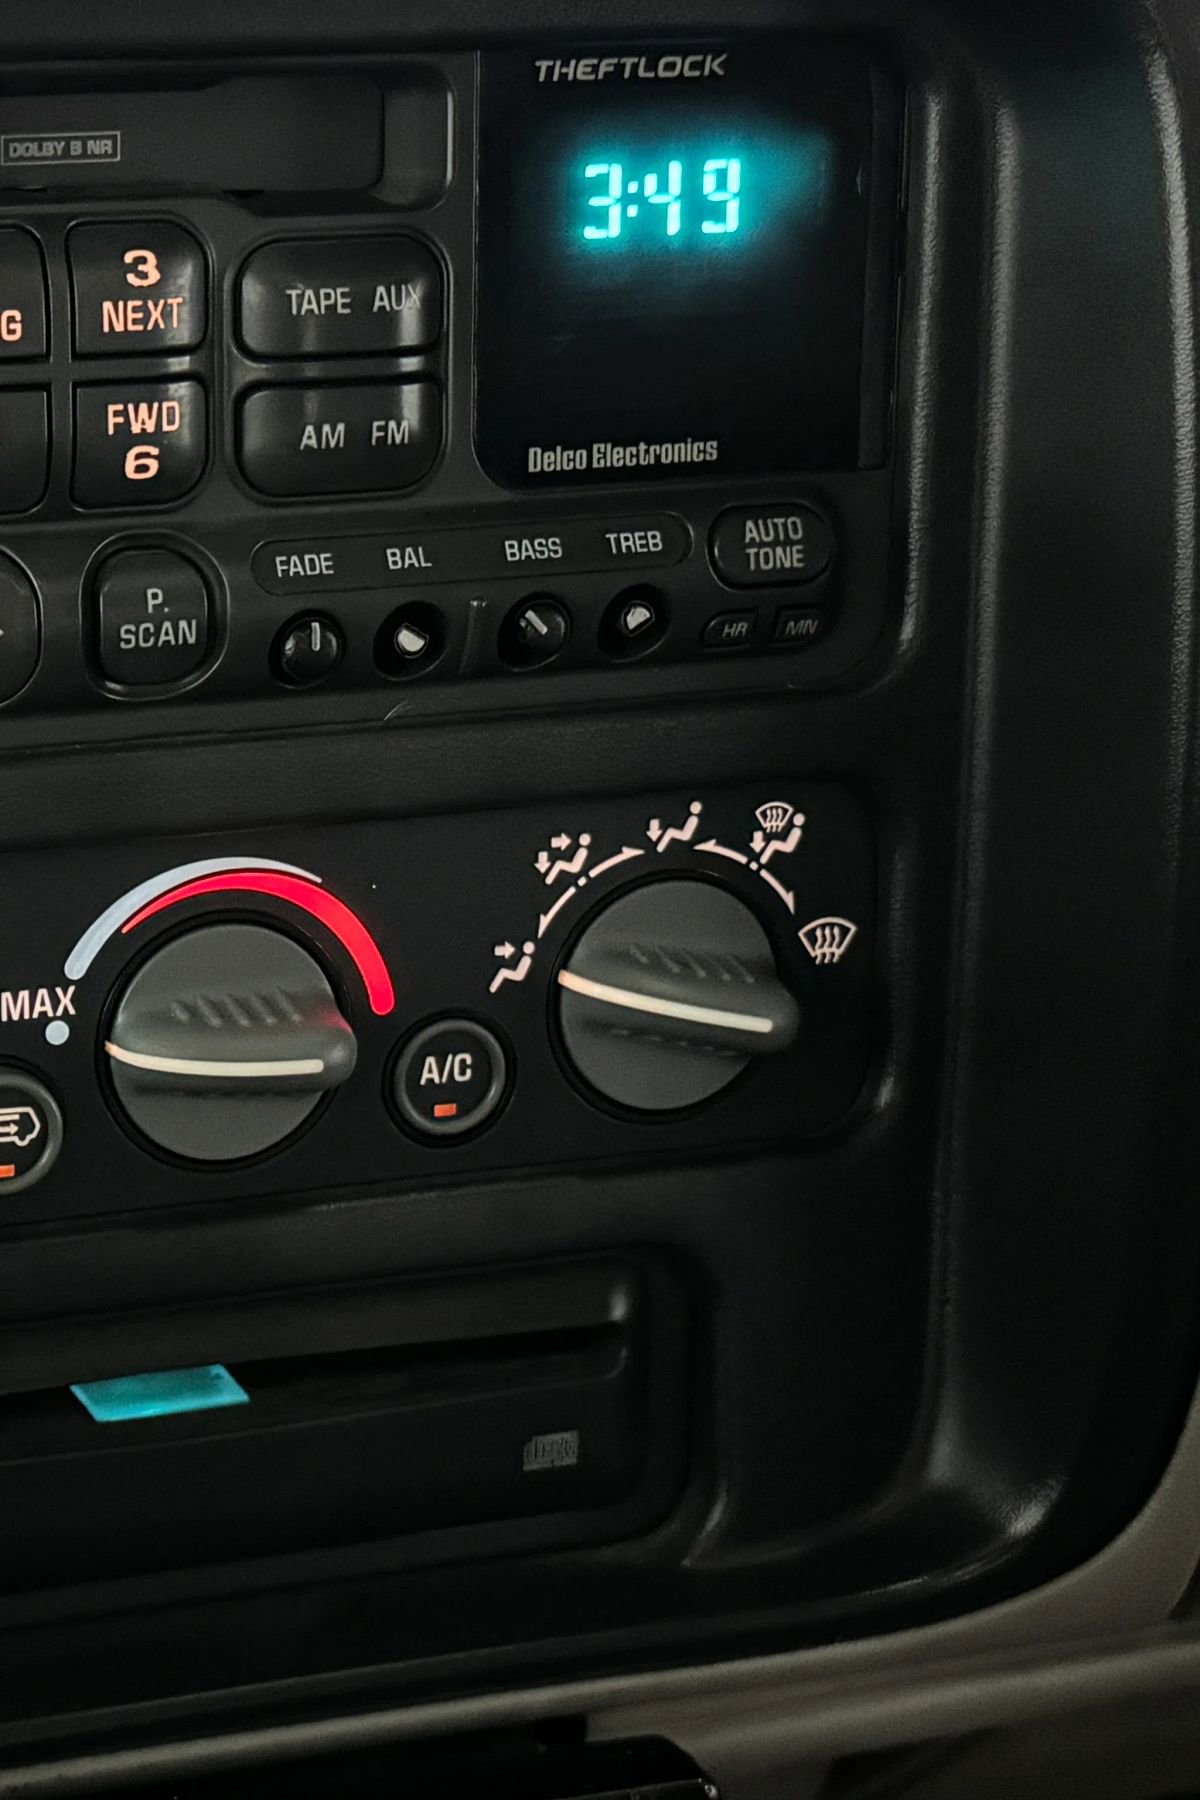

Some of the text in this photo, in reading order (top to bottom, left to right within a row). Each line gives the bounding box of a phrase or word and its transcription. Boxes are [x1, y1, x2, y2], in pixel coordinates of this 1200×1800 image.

[535, 54, 728, 83] THEFTLOCK
[9, 139, 113, 158] DOLBY B NR
[583, 158, 741, 240] 3:49
[123, 249, 161, 287] 3
[101, 297, 183, 332] NEXT
[286, 284, 422, 316] TAPE AUX
[107, 402, 180, 436] FWD
[300, 421, 410, 450] AM FM
[124, 446, 159, 480] 6
[528, 438, 719, 473] Delco Electronics
[605, 530, 663, 555] TREB
[744, 516, 804, 544] AUTO
[385, 546, 433, 570] BAL
[504, 537, 563, 562] BASS
[745, 545, 805, 571] TONE
[274, 553, 335, 578] FADE
[146, 588, 170, 613] P.
[118, 618, 197, 651] SCAN
[721, 621, 749, 638] HR
[0, 984, 76, 1021] MAX
[420, 1052, 474, 1086] A/C
